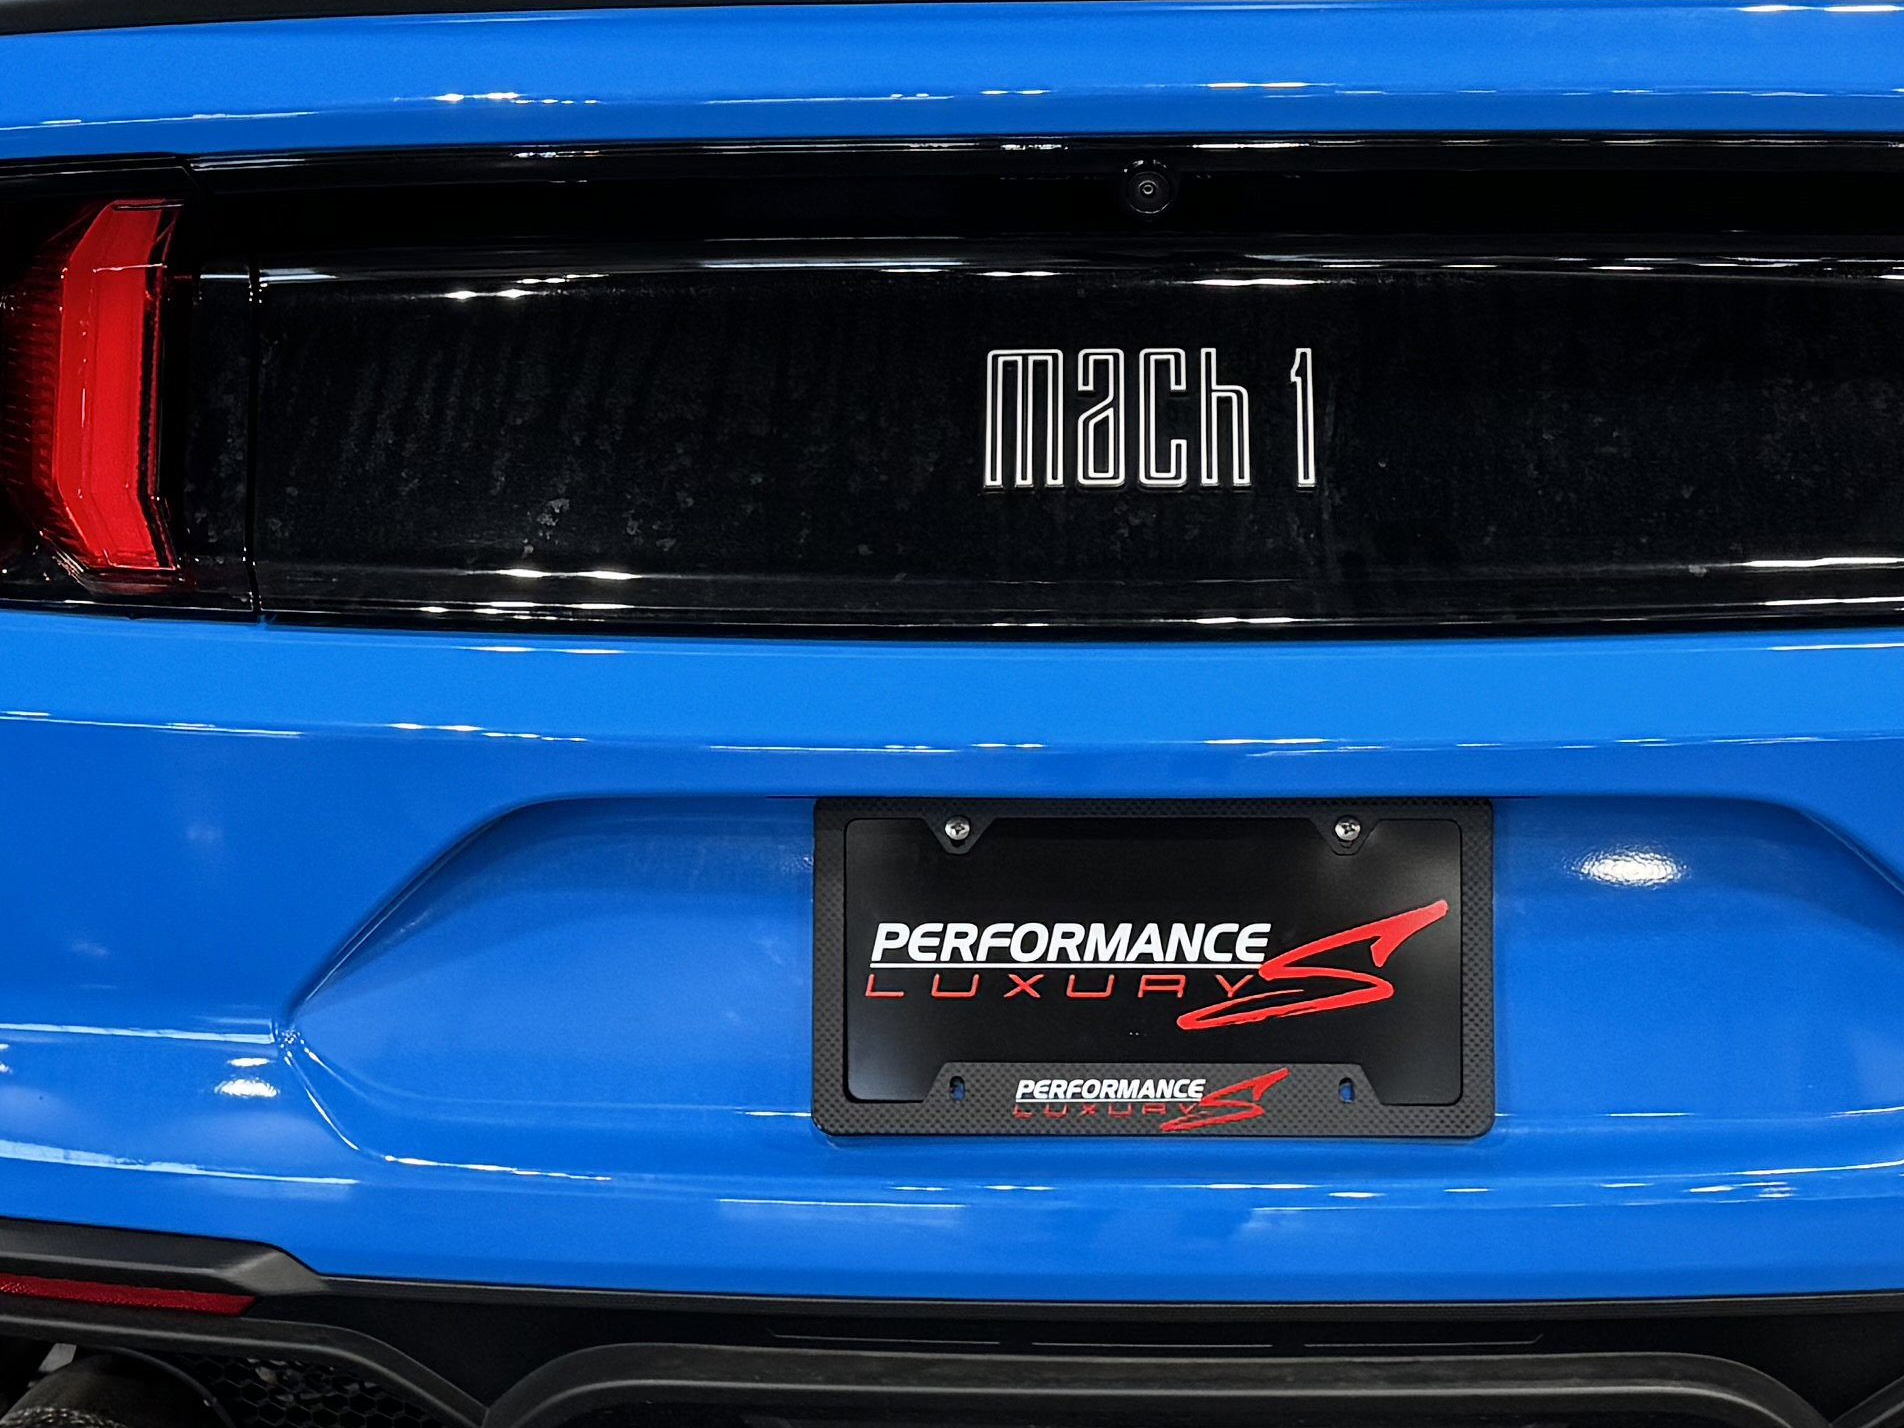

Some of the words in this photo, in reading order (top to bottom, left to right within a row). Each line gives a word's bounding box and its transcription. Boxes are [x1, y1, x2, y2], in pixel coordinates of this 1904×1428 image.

[1290, 347, 1317, 488] 1
[872, 922, 1272, 963] PERFORMANCE
[865, 973, 1256, 998] LUXURY
[1015, 1078, 1206, 1100] PERFORMANCE
[1012, 1103, 1196, 1119] LUXURY
